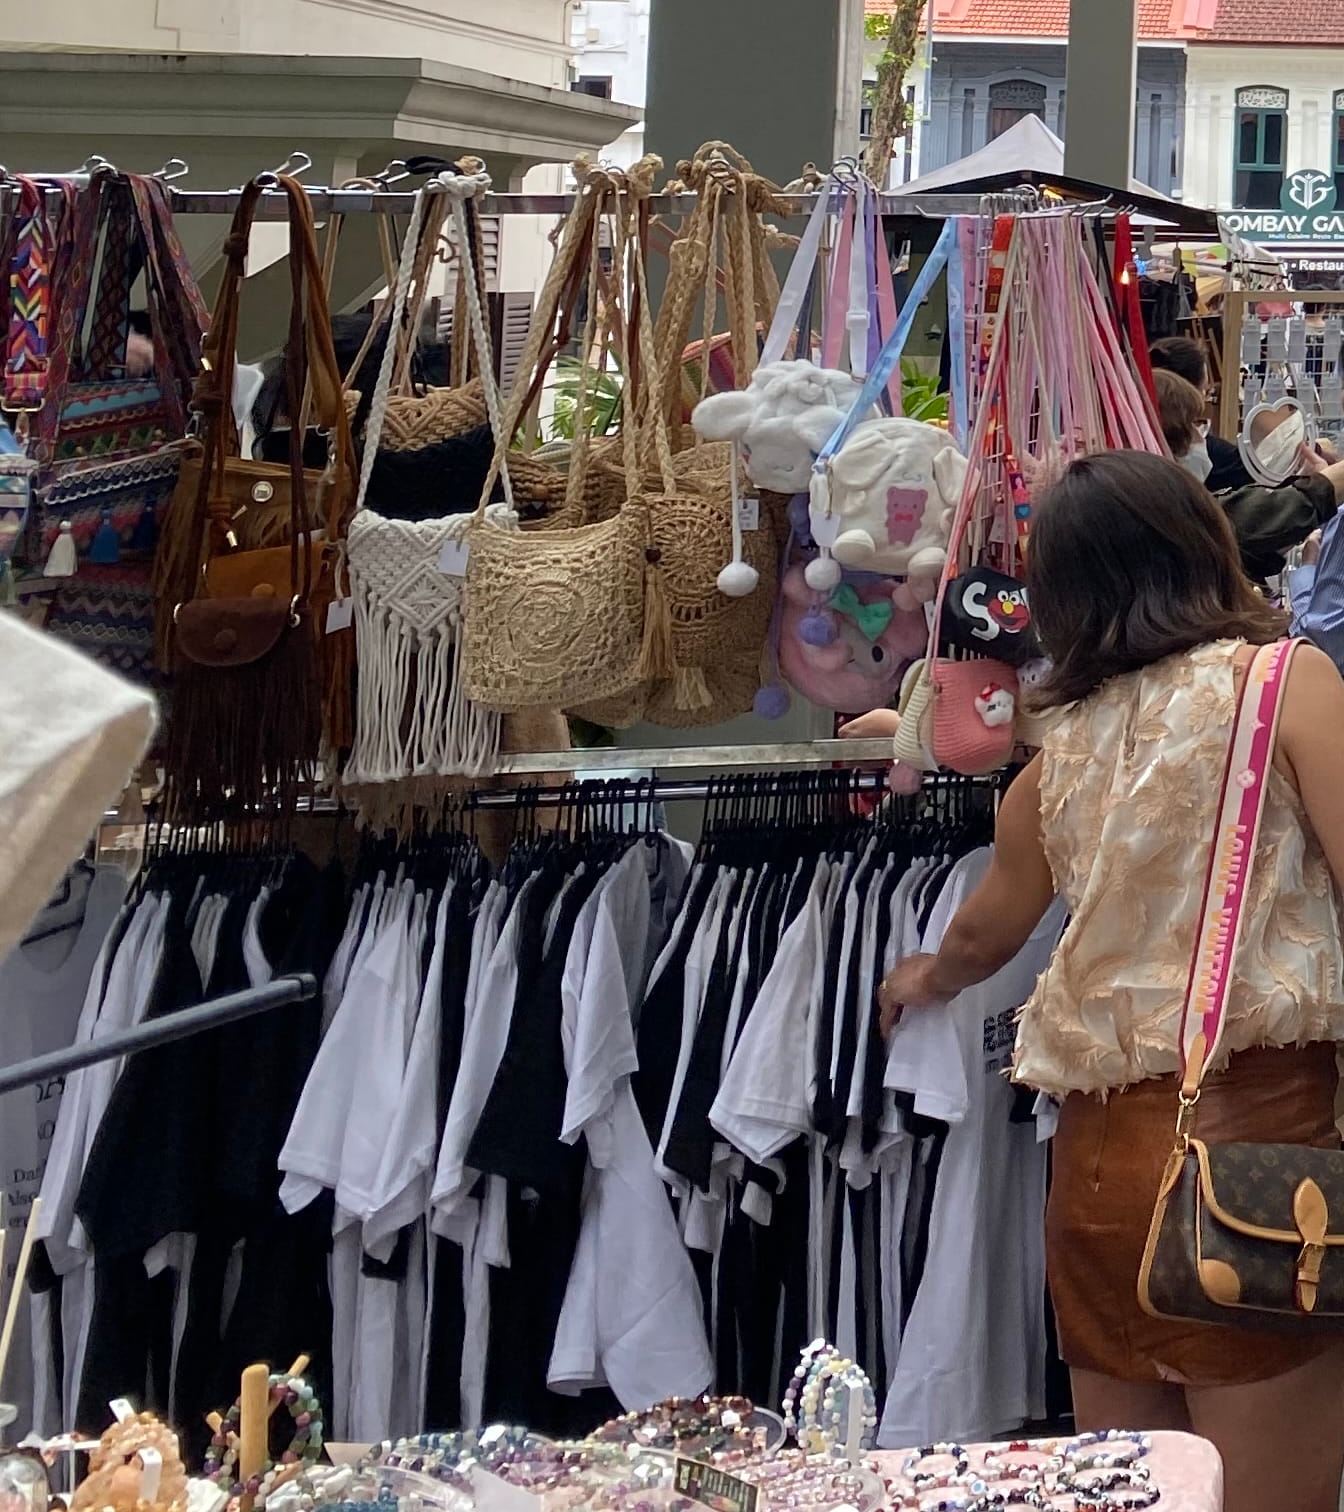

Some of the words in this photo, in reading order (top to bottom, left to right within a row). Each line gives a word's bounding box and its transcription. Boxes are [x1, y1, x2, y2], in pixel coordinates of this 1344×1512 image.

[1218, 215, 1308, 233] OMBAY
[1215, 824, 1247, 896] LOUIS
[1194, 906, 1233, 1014] VUITTON
